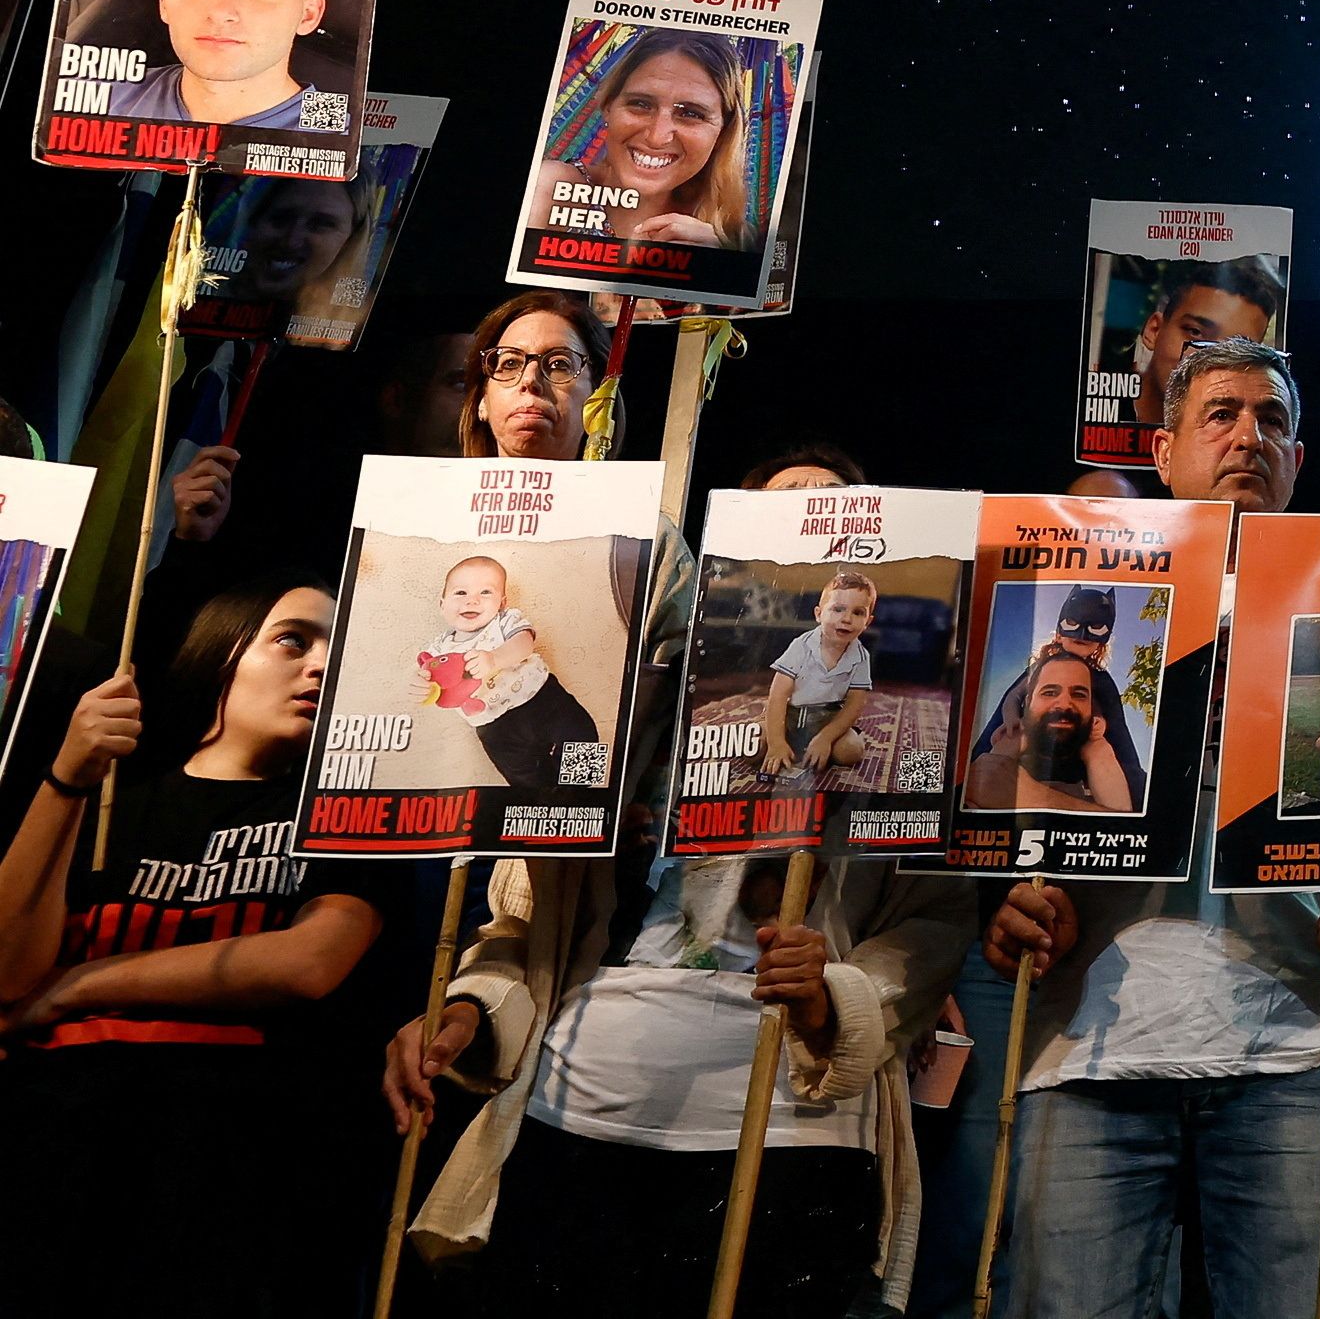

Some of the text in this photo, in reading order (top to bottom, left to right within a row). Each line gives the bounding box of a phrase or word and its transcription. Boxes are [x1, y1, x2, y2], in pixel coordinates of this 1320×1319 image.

[593, 0, 791, 35] DORON STEINBRECHER
[59, 44, 147, 82] BRING
[548, 206, 607, 230] HER
[1158, 210, 1225, 227] עידן אלכסנדר
[1147, 225, 1233, 242] EDAN ALEXANDER
[539, 236, 692, 271] HOME NOW
[1179, 241, 1200, 257] (20)
[1085, 398, 1120, 423] HIM
[480, 469, 552, 491] כפיר ביבס
[470, 492, 553, 512] KFIR BIBAS
[806, 496, 882, 515] אריאל ביבס
[477, 514, 539, 536] (בן שנה)
[800, 517, 882, 536] ARIEL BIBAS
[1016, 525, 1164, 545] גם לירדן ואריאל
[848, 537, 887, 560] (5)
[1001, 545, 1171, 573] מגיע חופש
[505, 805, 604, 820] HOSTAGES AND MISSING
[851, 810, 940, 823] HOSTAGES AND MISSING
[502, 817, 602, 839] FAMILIES FORUM
[849, 821, 939, 840] FAMILIES FORUM
[954, 829, 1148, 866] אריאל מציין 5 בשבי
[1264, 843, 1320, 860] בשבי
[946, 849, 1145, 867] יום הולדת חמאס
[128, 856, 308, 902] אותם הביתה
[1257, 863, 1320, 881] חמאס
